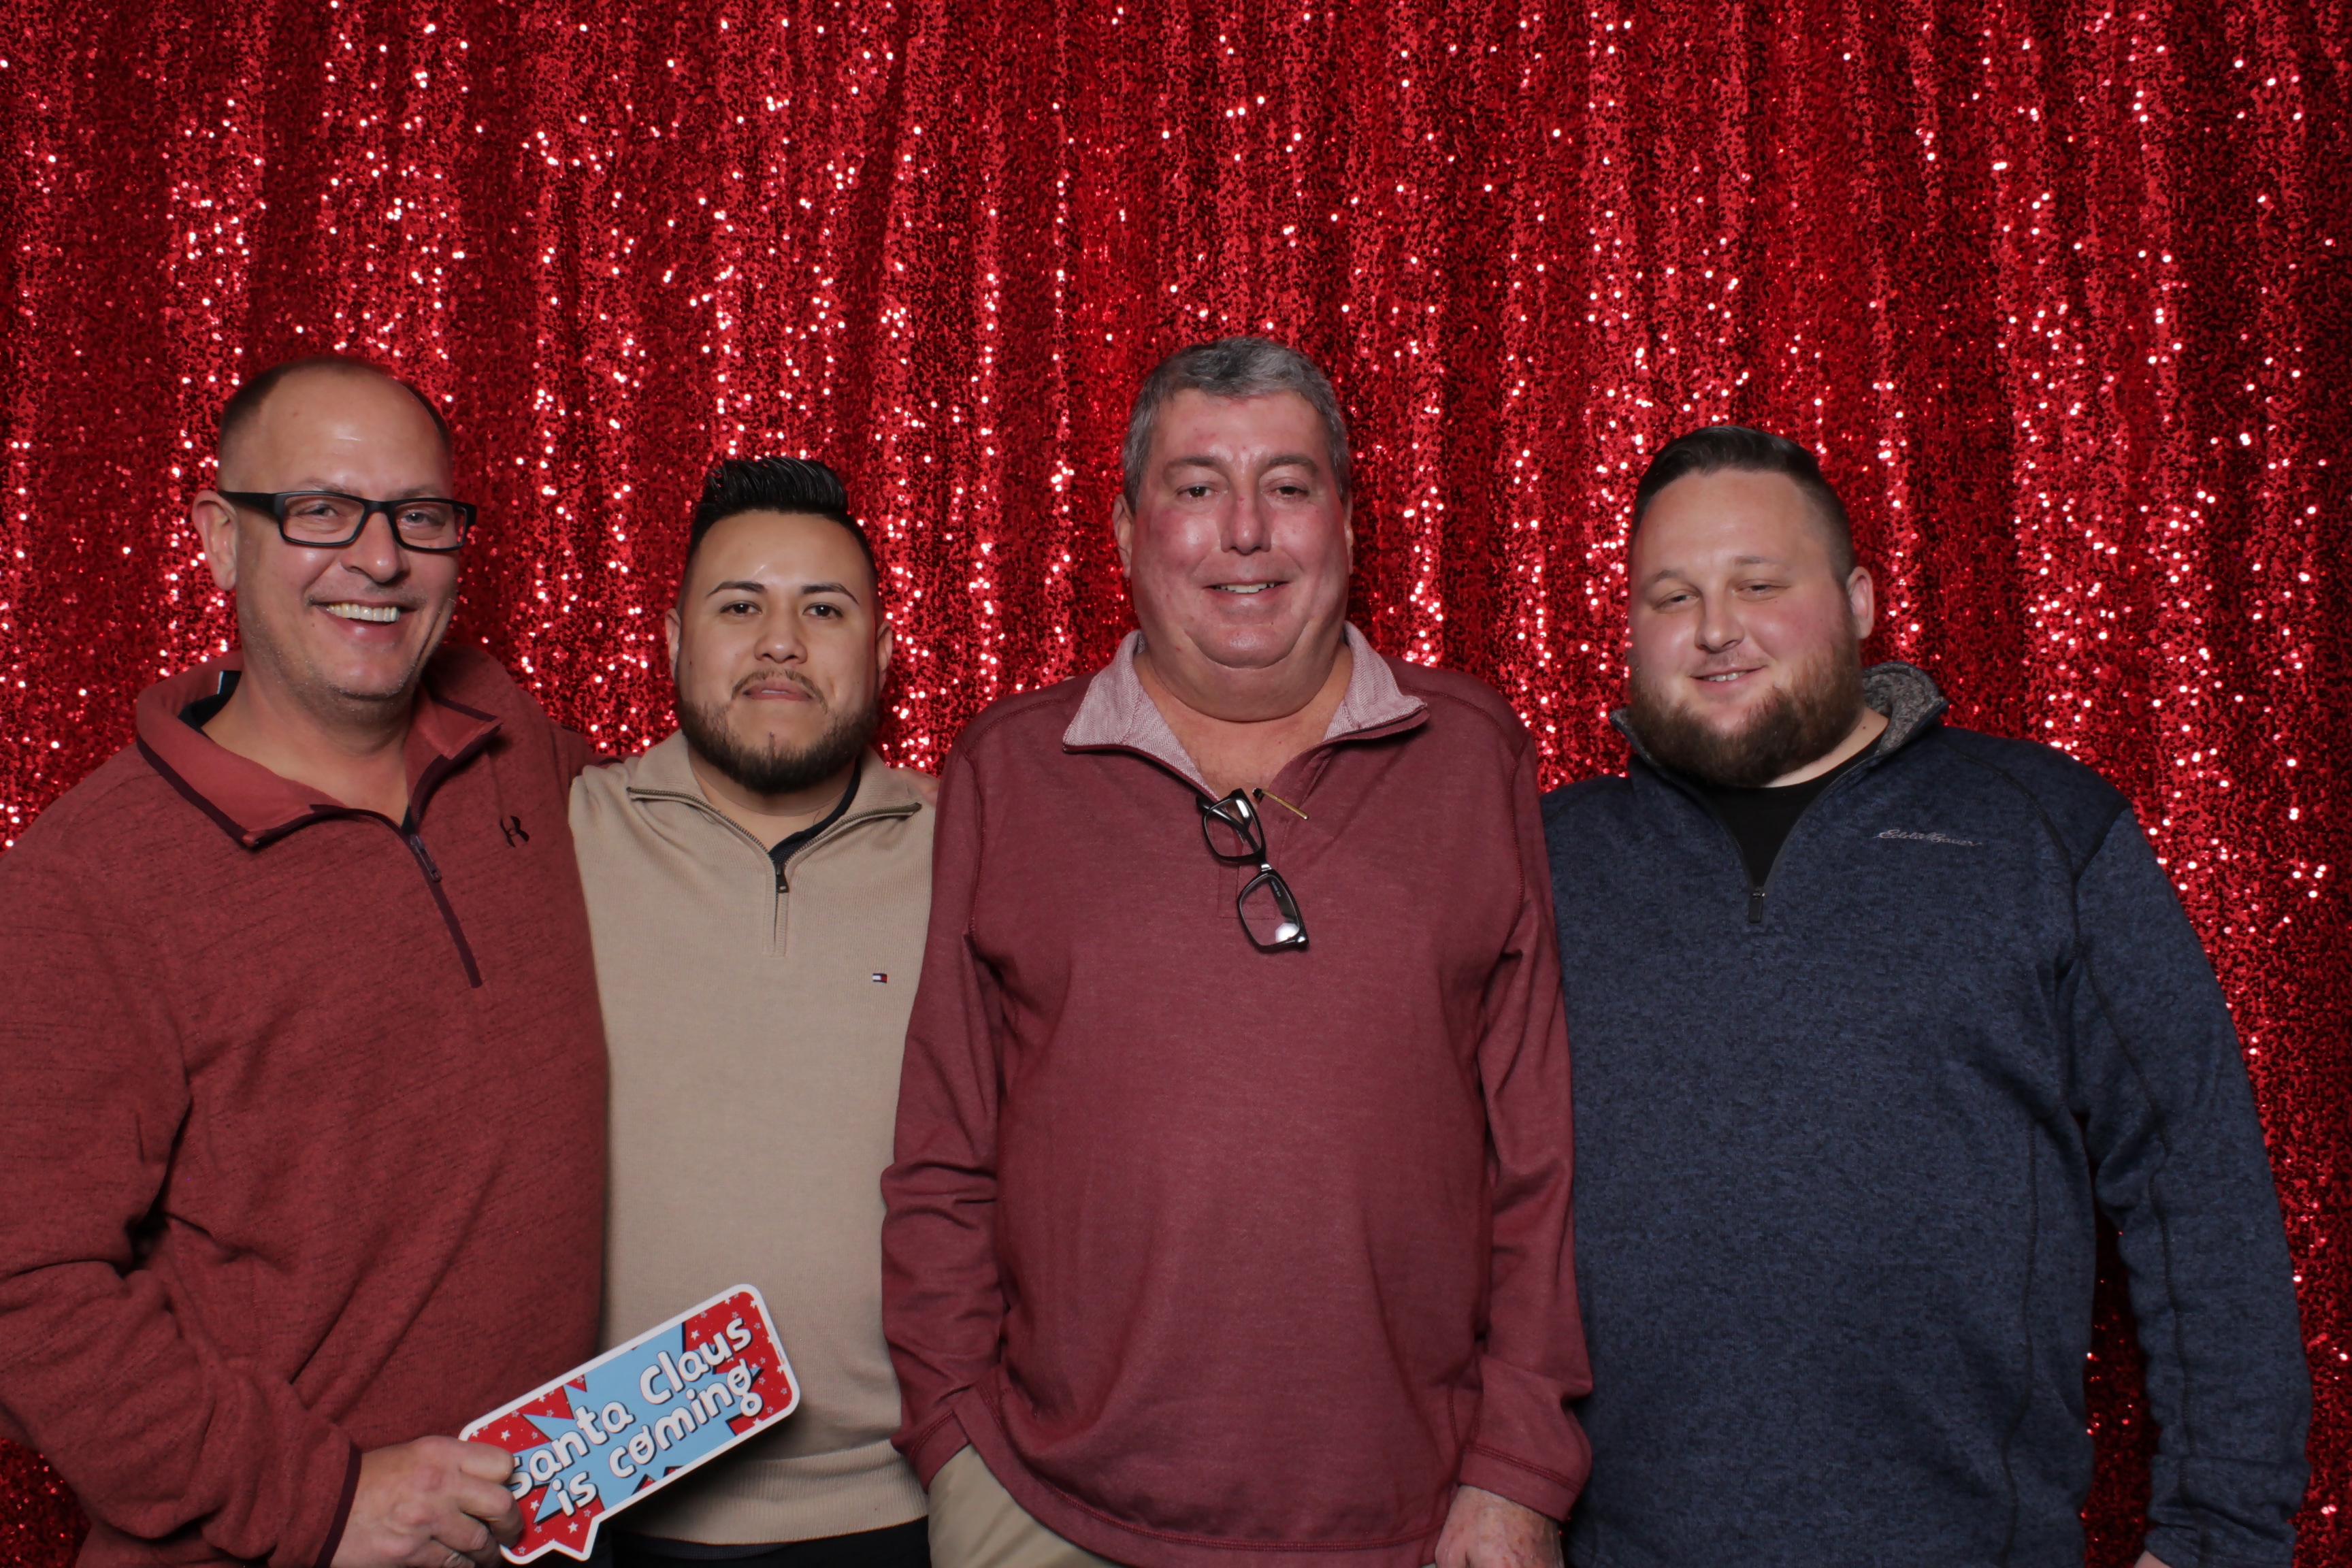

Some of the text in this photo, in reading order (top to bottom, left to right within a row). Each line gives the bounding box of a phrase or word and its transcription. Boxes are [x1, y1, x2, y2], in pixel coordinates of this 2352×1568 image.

[510, 1318, 752, 1501] Santa Claus
[552, 1358, 764, 1518] is coming
